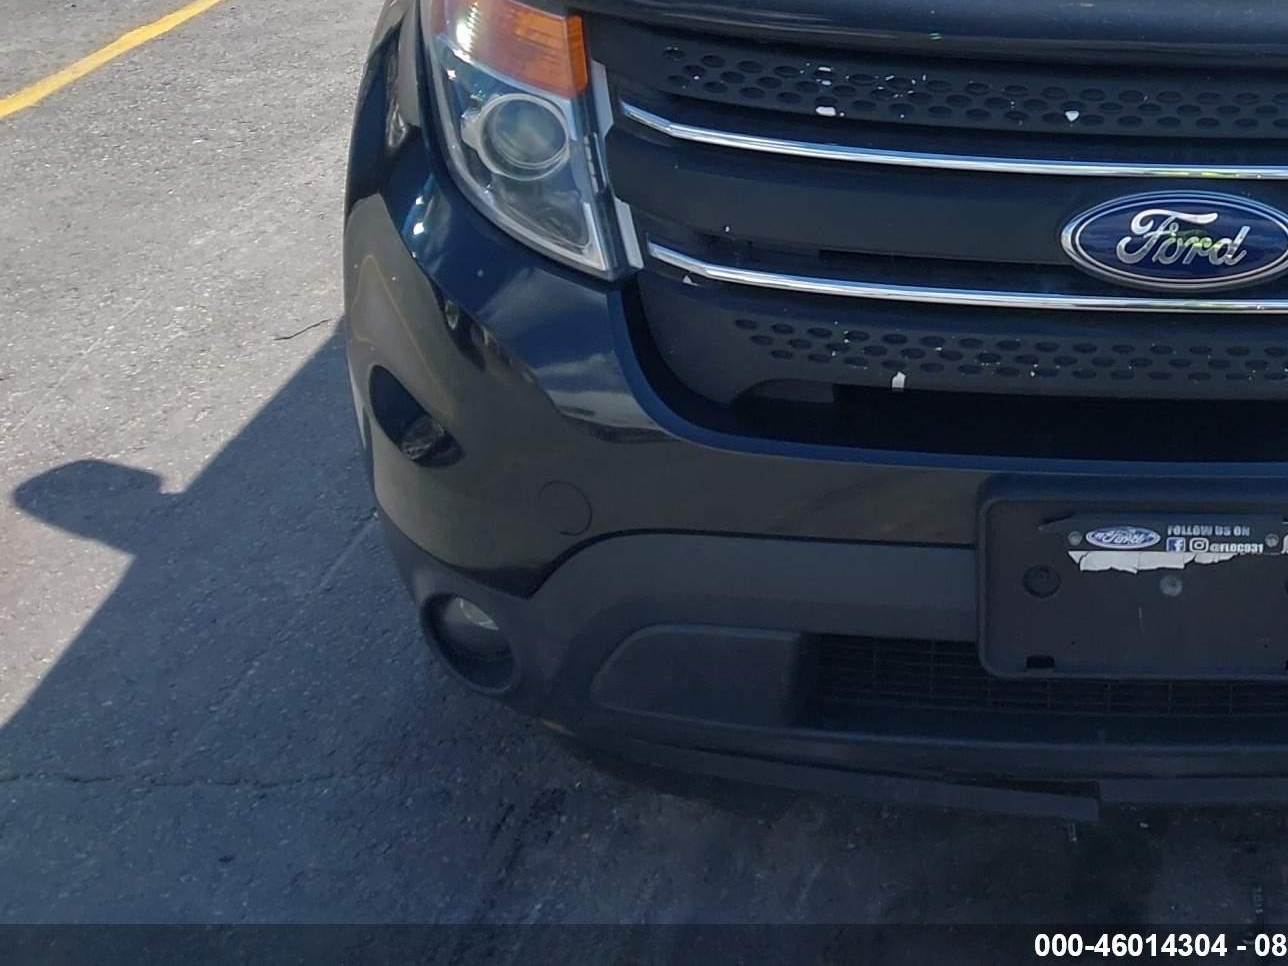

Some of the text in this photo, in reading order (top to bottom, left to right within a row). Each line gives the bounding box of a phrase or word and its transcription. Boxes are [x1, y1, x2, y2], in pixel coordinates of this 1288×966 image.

[1116, 209, 1251, 266] Ford
[1167, 525, 1251, 536] FOLLOW US ON
